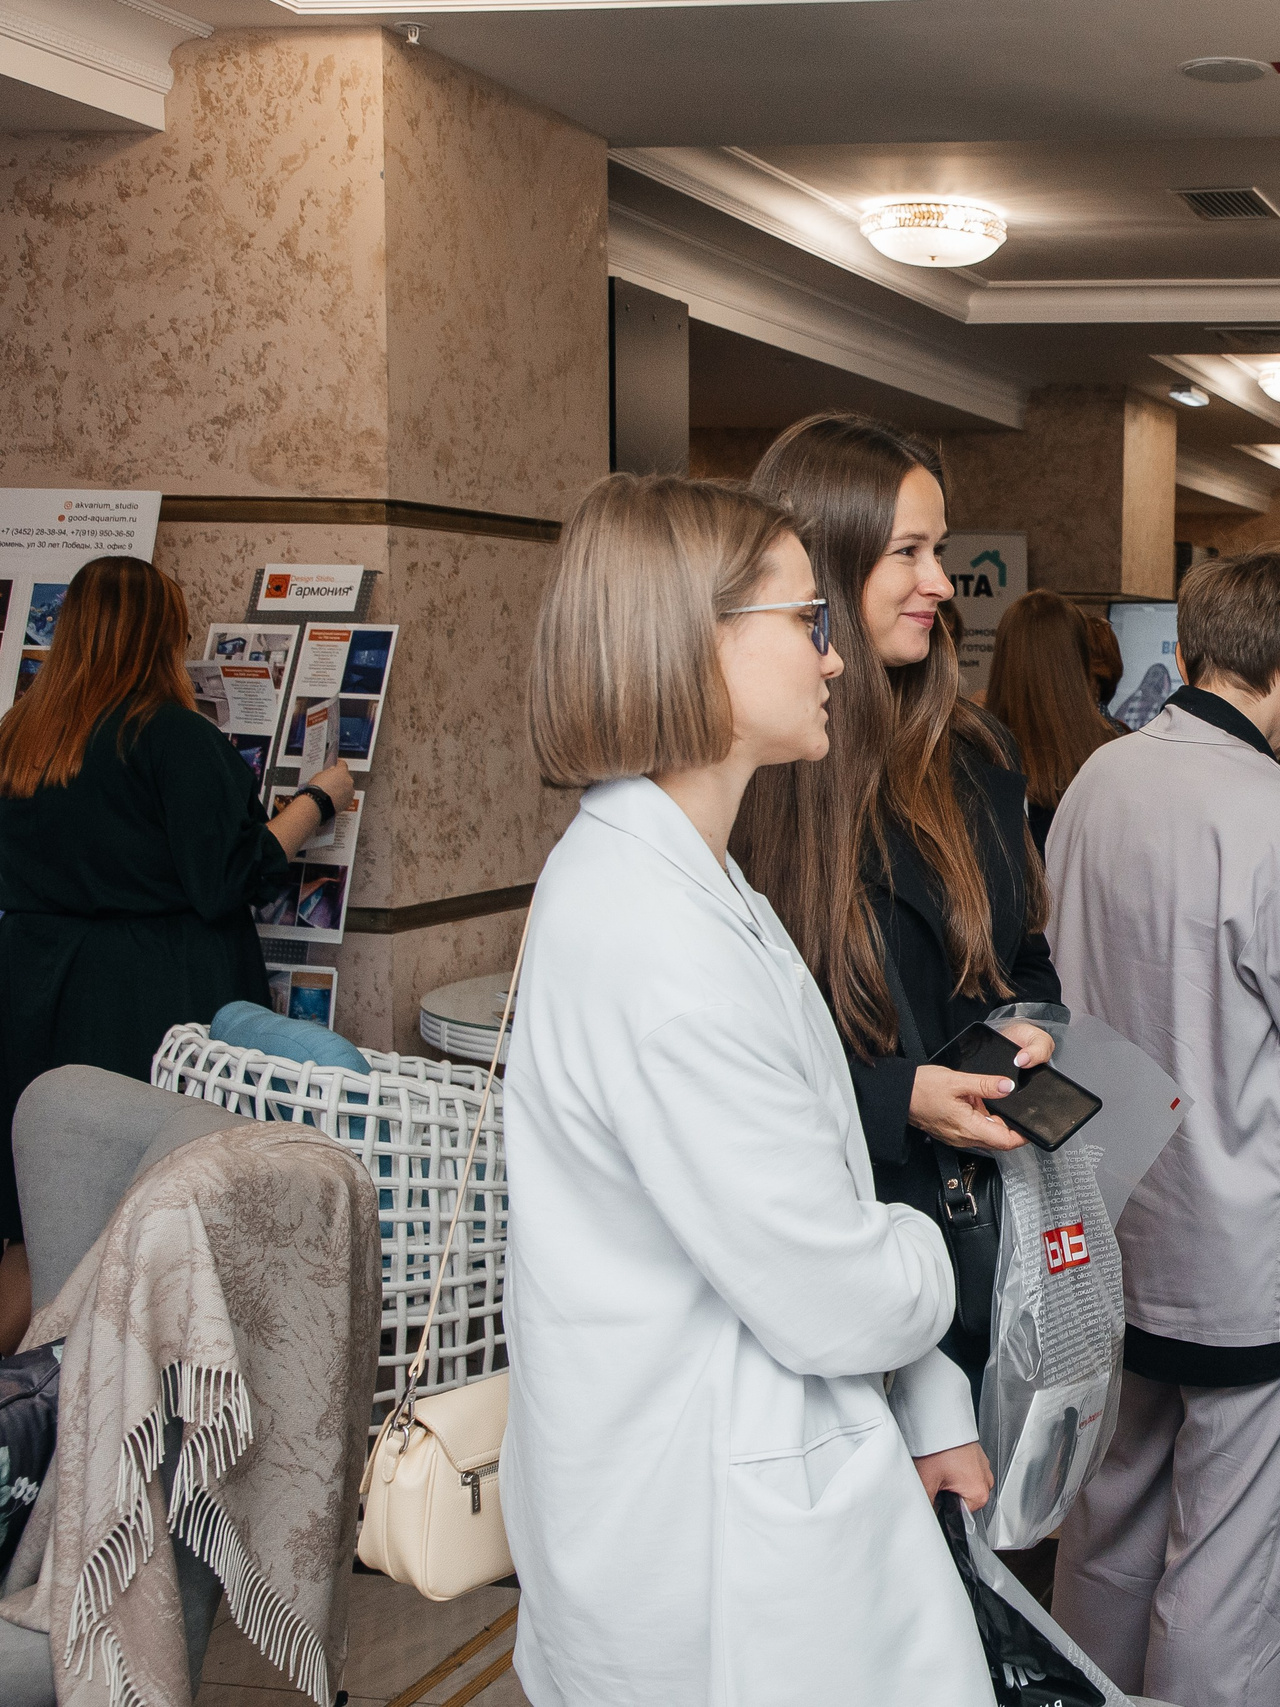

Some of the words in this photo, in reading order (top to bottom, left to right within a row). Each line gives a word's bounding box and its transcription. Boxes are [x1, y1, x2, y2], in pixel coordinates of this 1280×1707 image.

[75, 501, 139, 511] akvarium_studio
[67, 514, 137, 523] good-aquarium.ru
[288, 583, 351, 599] Гармония
